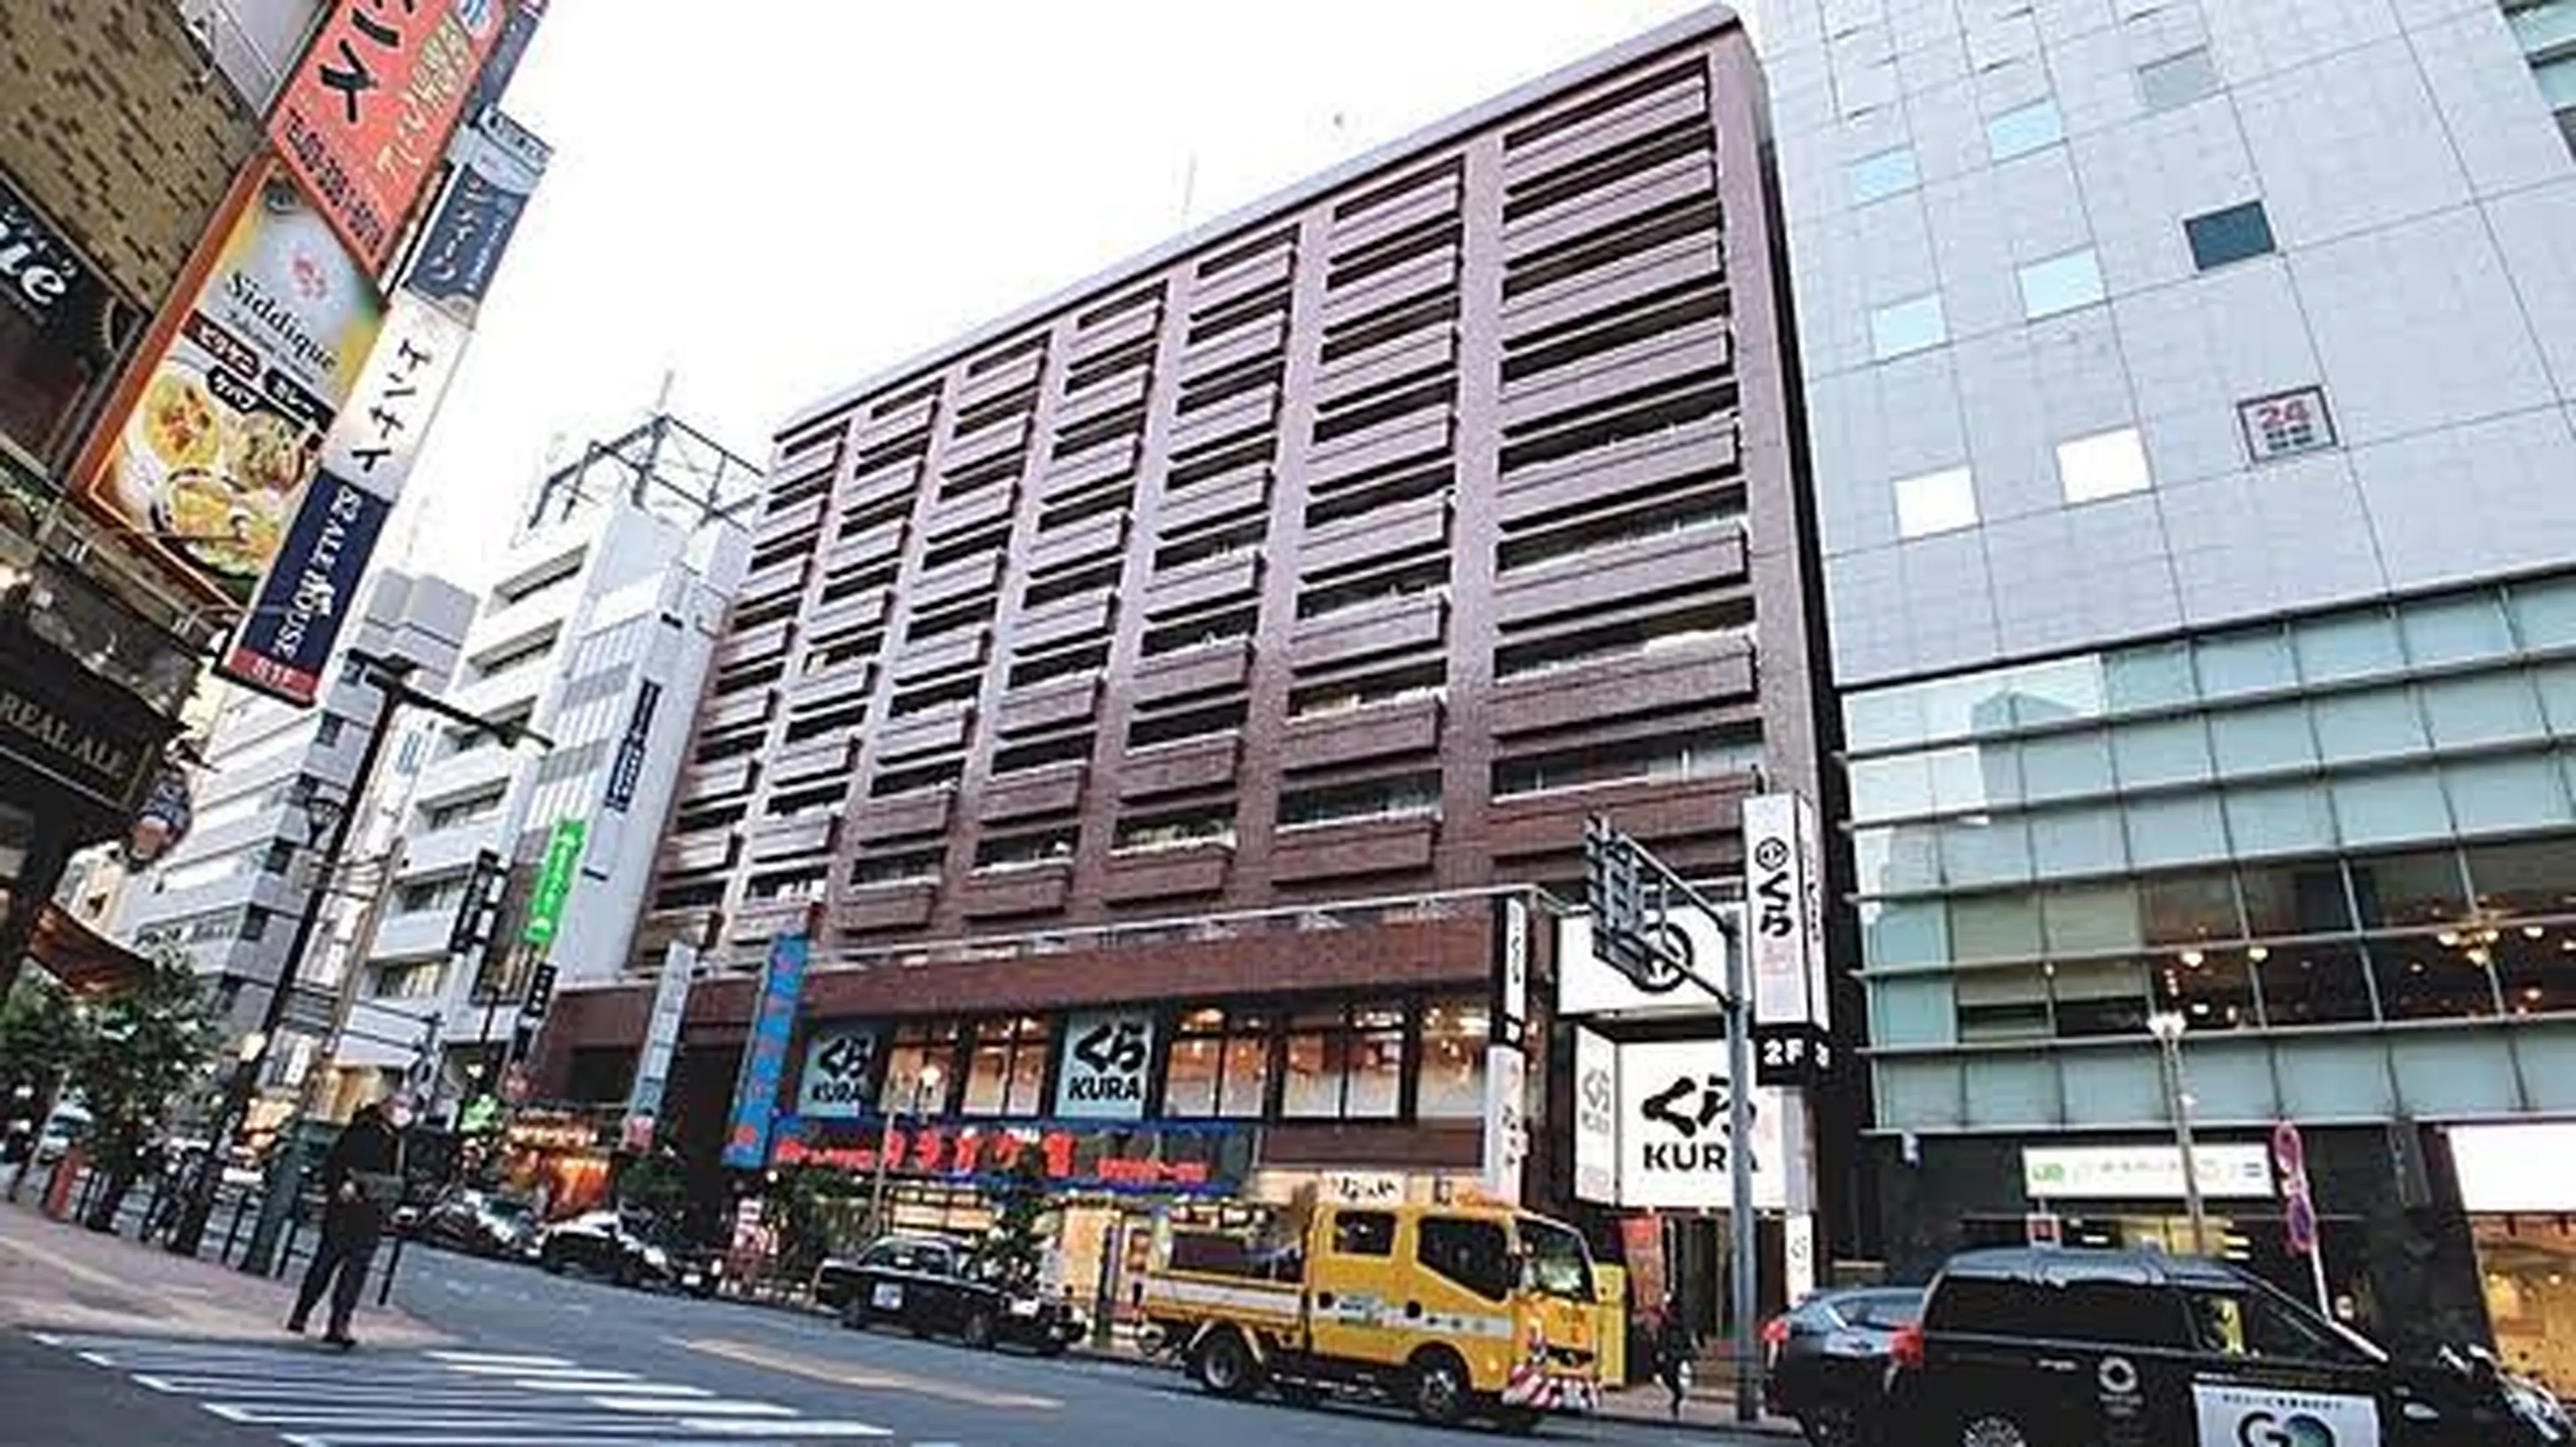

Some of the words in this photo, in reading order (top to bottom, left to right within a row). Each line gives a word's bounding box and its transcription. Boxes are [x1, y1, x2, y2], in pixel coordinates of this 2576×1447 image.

[225, 270, 339, 372] Siddique
[1, 691, 71, 751] REAL
[1757, 871, 1793, 937] くら
[1075, 1022, 1146, 1074] くら
[1763, 1037, 1805, 1067] 2F
[1069, 1075, 1141, 1100] KURA
[1642, 1073, 1758, 1138] くら
